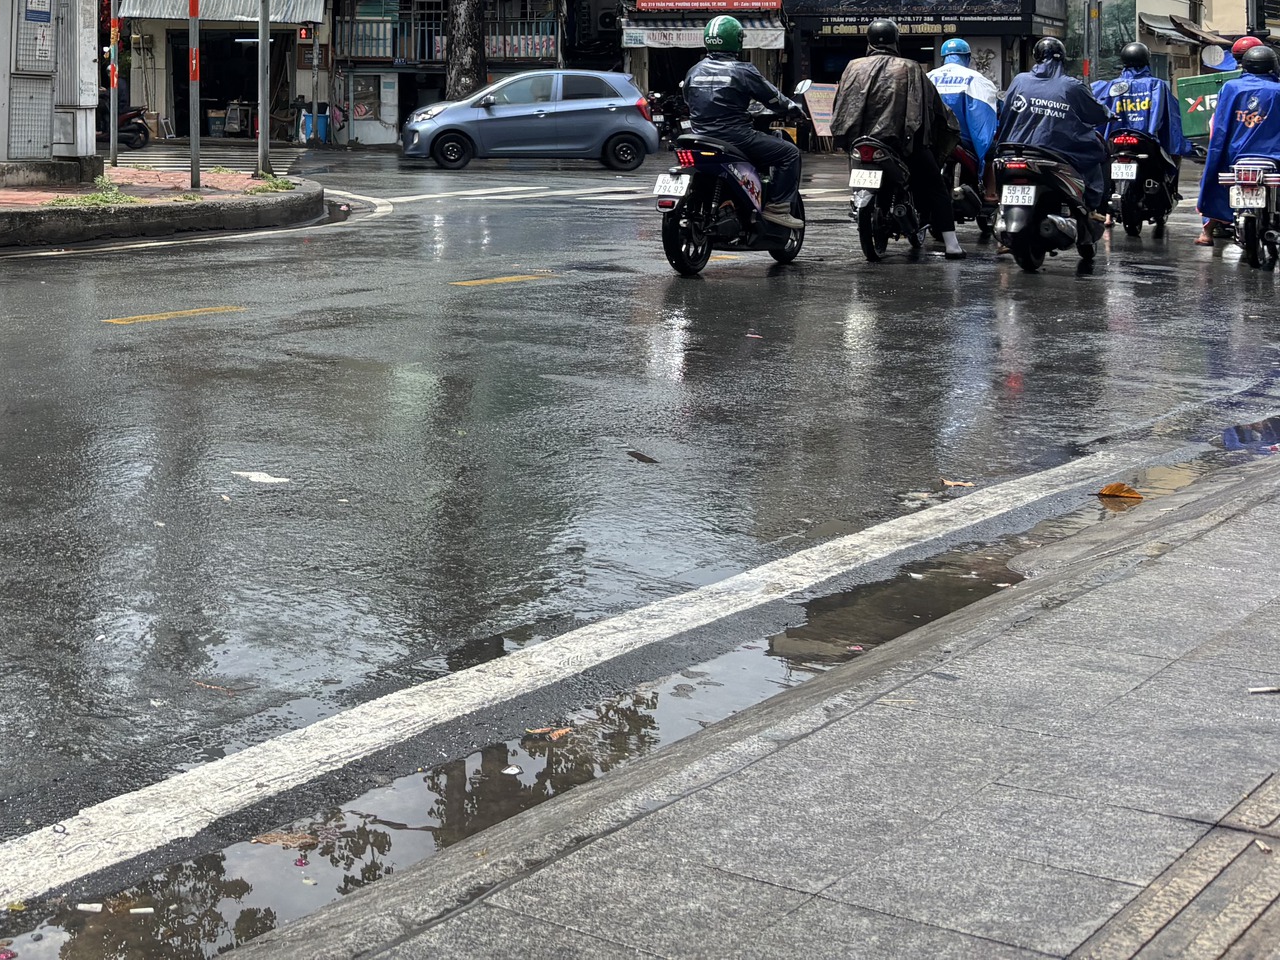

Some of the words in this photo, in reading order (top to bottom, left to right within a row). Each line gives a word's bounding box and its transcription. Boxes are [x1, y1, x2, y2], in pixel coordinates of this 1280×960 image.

[833, 24, 857, 34] CÔNG
[911, 23, 942, 34] TƯỜNG
[944, 24, 956, 33] 3D
[705, 36, 723, 44] Grab
[1030, 97, 1070, 111] TONGWEI
[1030, 106, 1066, 119] VIETNAM
